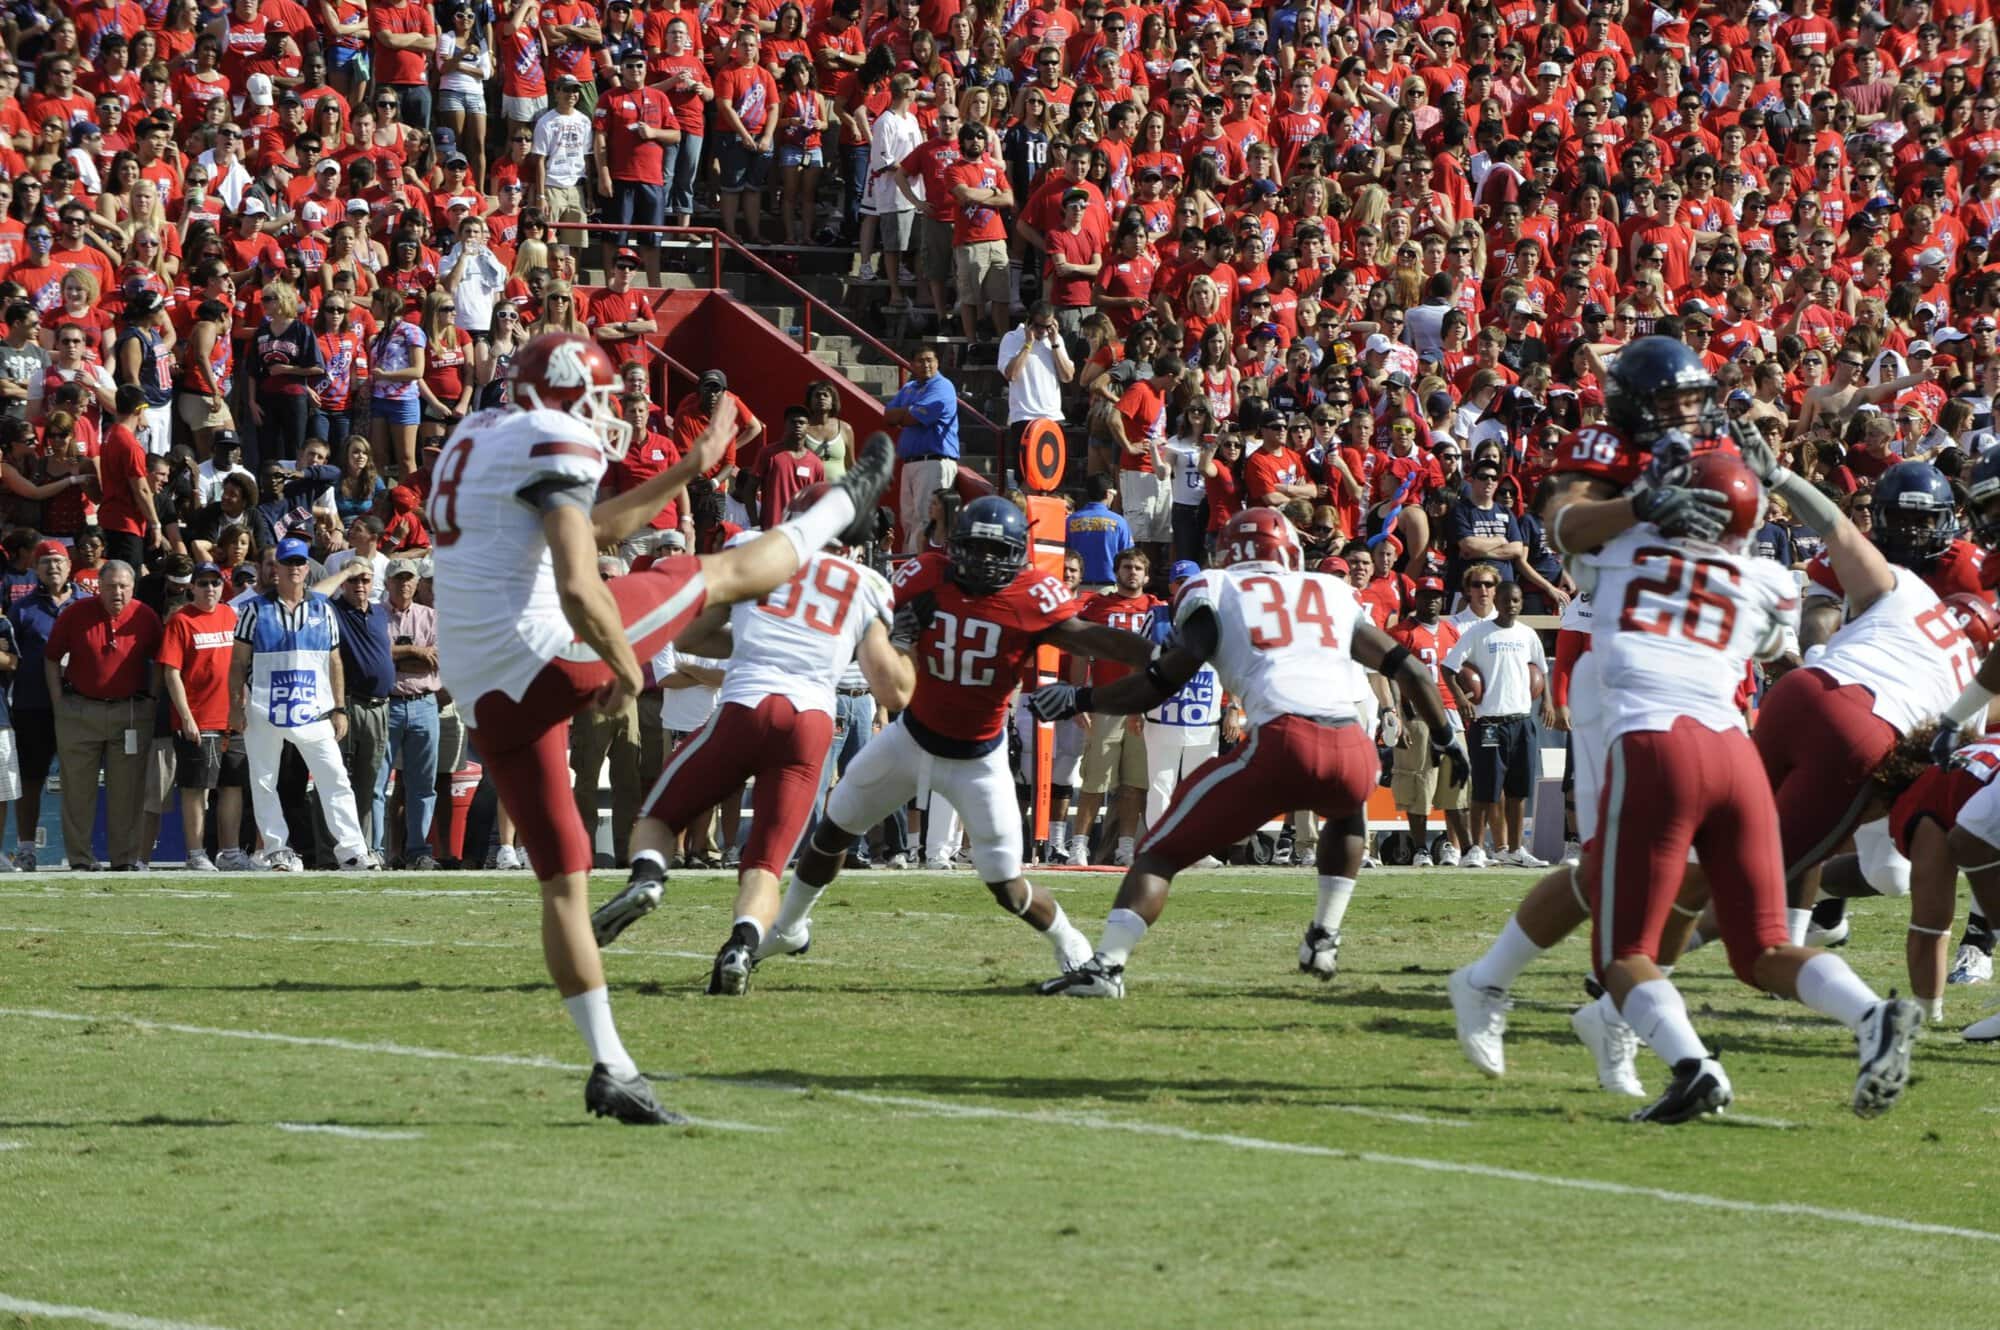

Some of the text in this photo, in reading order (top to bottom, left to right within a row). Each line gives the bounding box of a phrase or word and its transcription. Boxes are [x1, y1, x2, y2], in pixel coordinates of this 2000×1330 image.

[1026, 141, 1048, 164] 18
[1036, 430, 1060, 479] 0
[1571, 427, 1620, 465] 38
[431, 437, 475, 547] 8
[1231, 540, 1257, 561] 34
[1028, 576, 1072, 614] 32
[1240, 576, 1339, 652] 34
[1619, 546, 1742, 650] 26
[927, 610, 1002, 686] 32
[272, 686, 317, 702] PAC
[1173, 687, 1212, 702] AC
[271, 703, 317, 726] 10
[1163, 703, 1210, 725] 10
